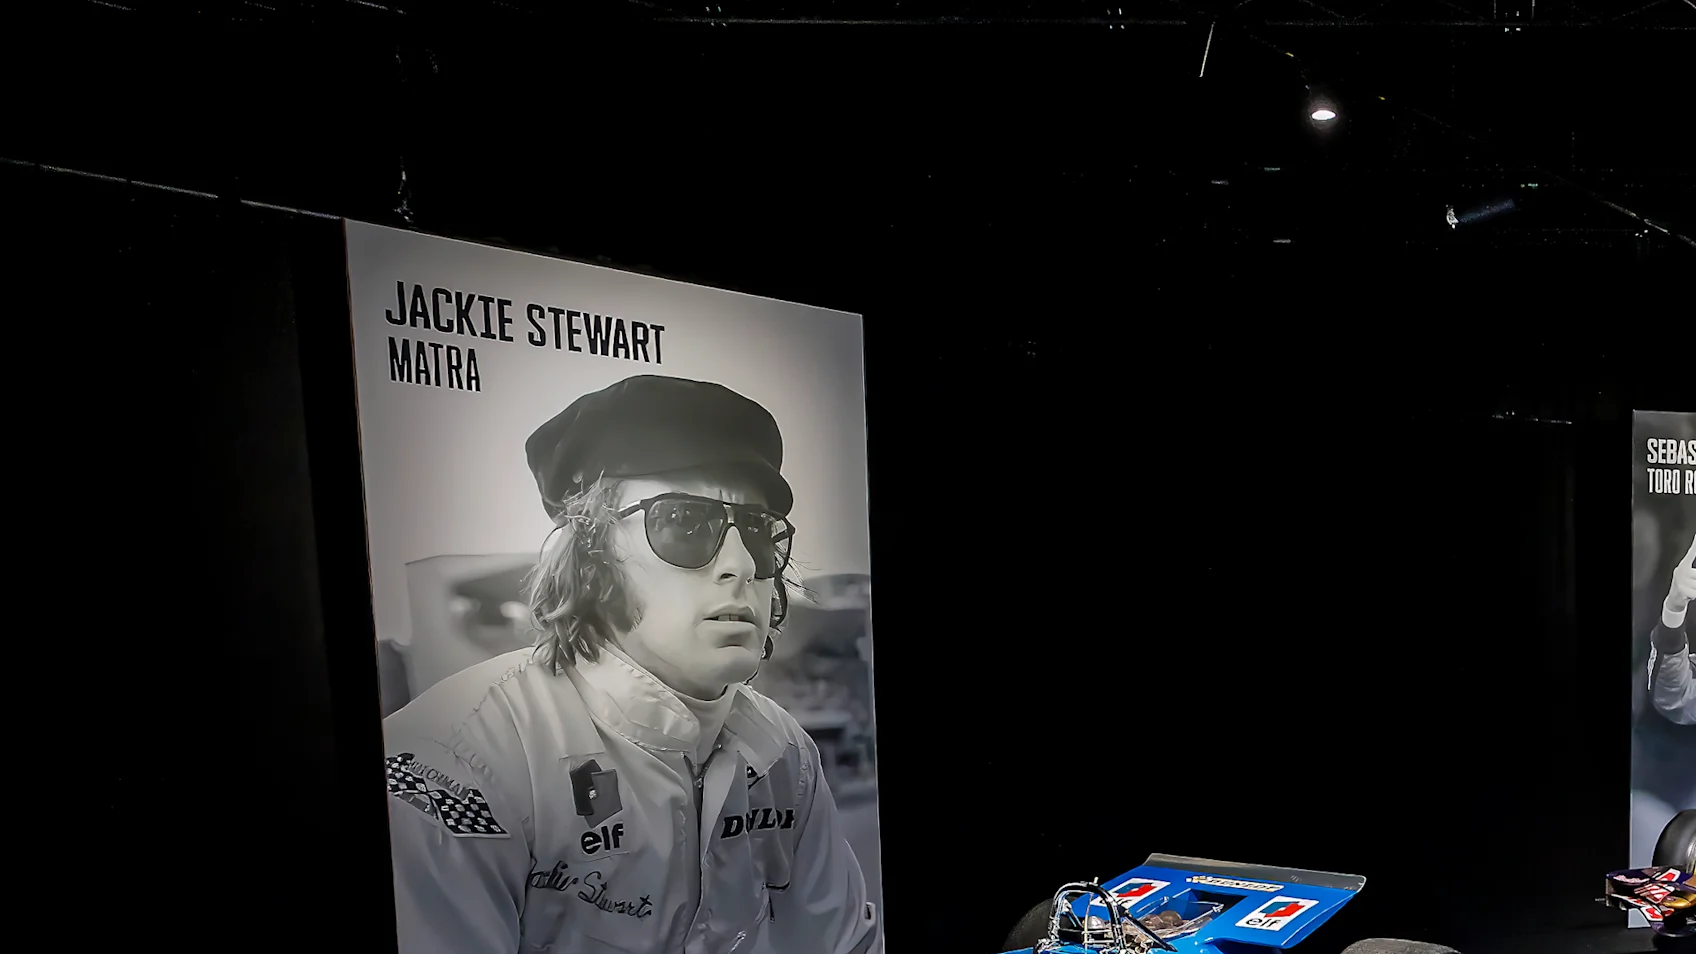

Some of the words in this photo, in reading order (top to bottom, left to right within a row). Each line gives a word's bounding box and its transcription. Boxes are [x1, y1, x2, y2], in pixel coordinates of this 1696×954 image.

[385, 280, 514, 343] JACKIE
[526, 303, 665, 365] STEWART
[388, 336, 481, 392] MATRA
[1647, 468, 1681, 494] TORO
[580, 823, 624, 855] elf
[1245, 917, 1285, 928] elf
